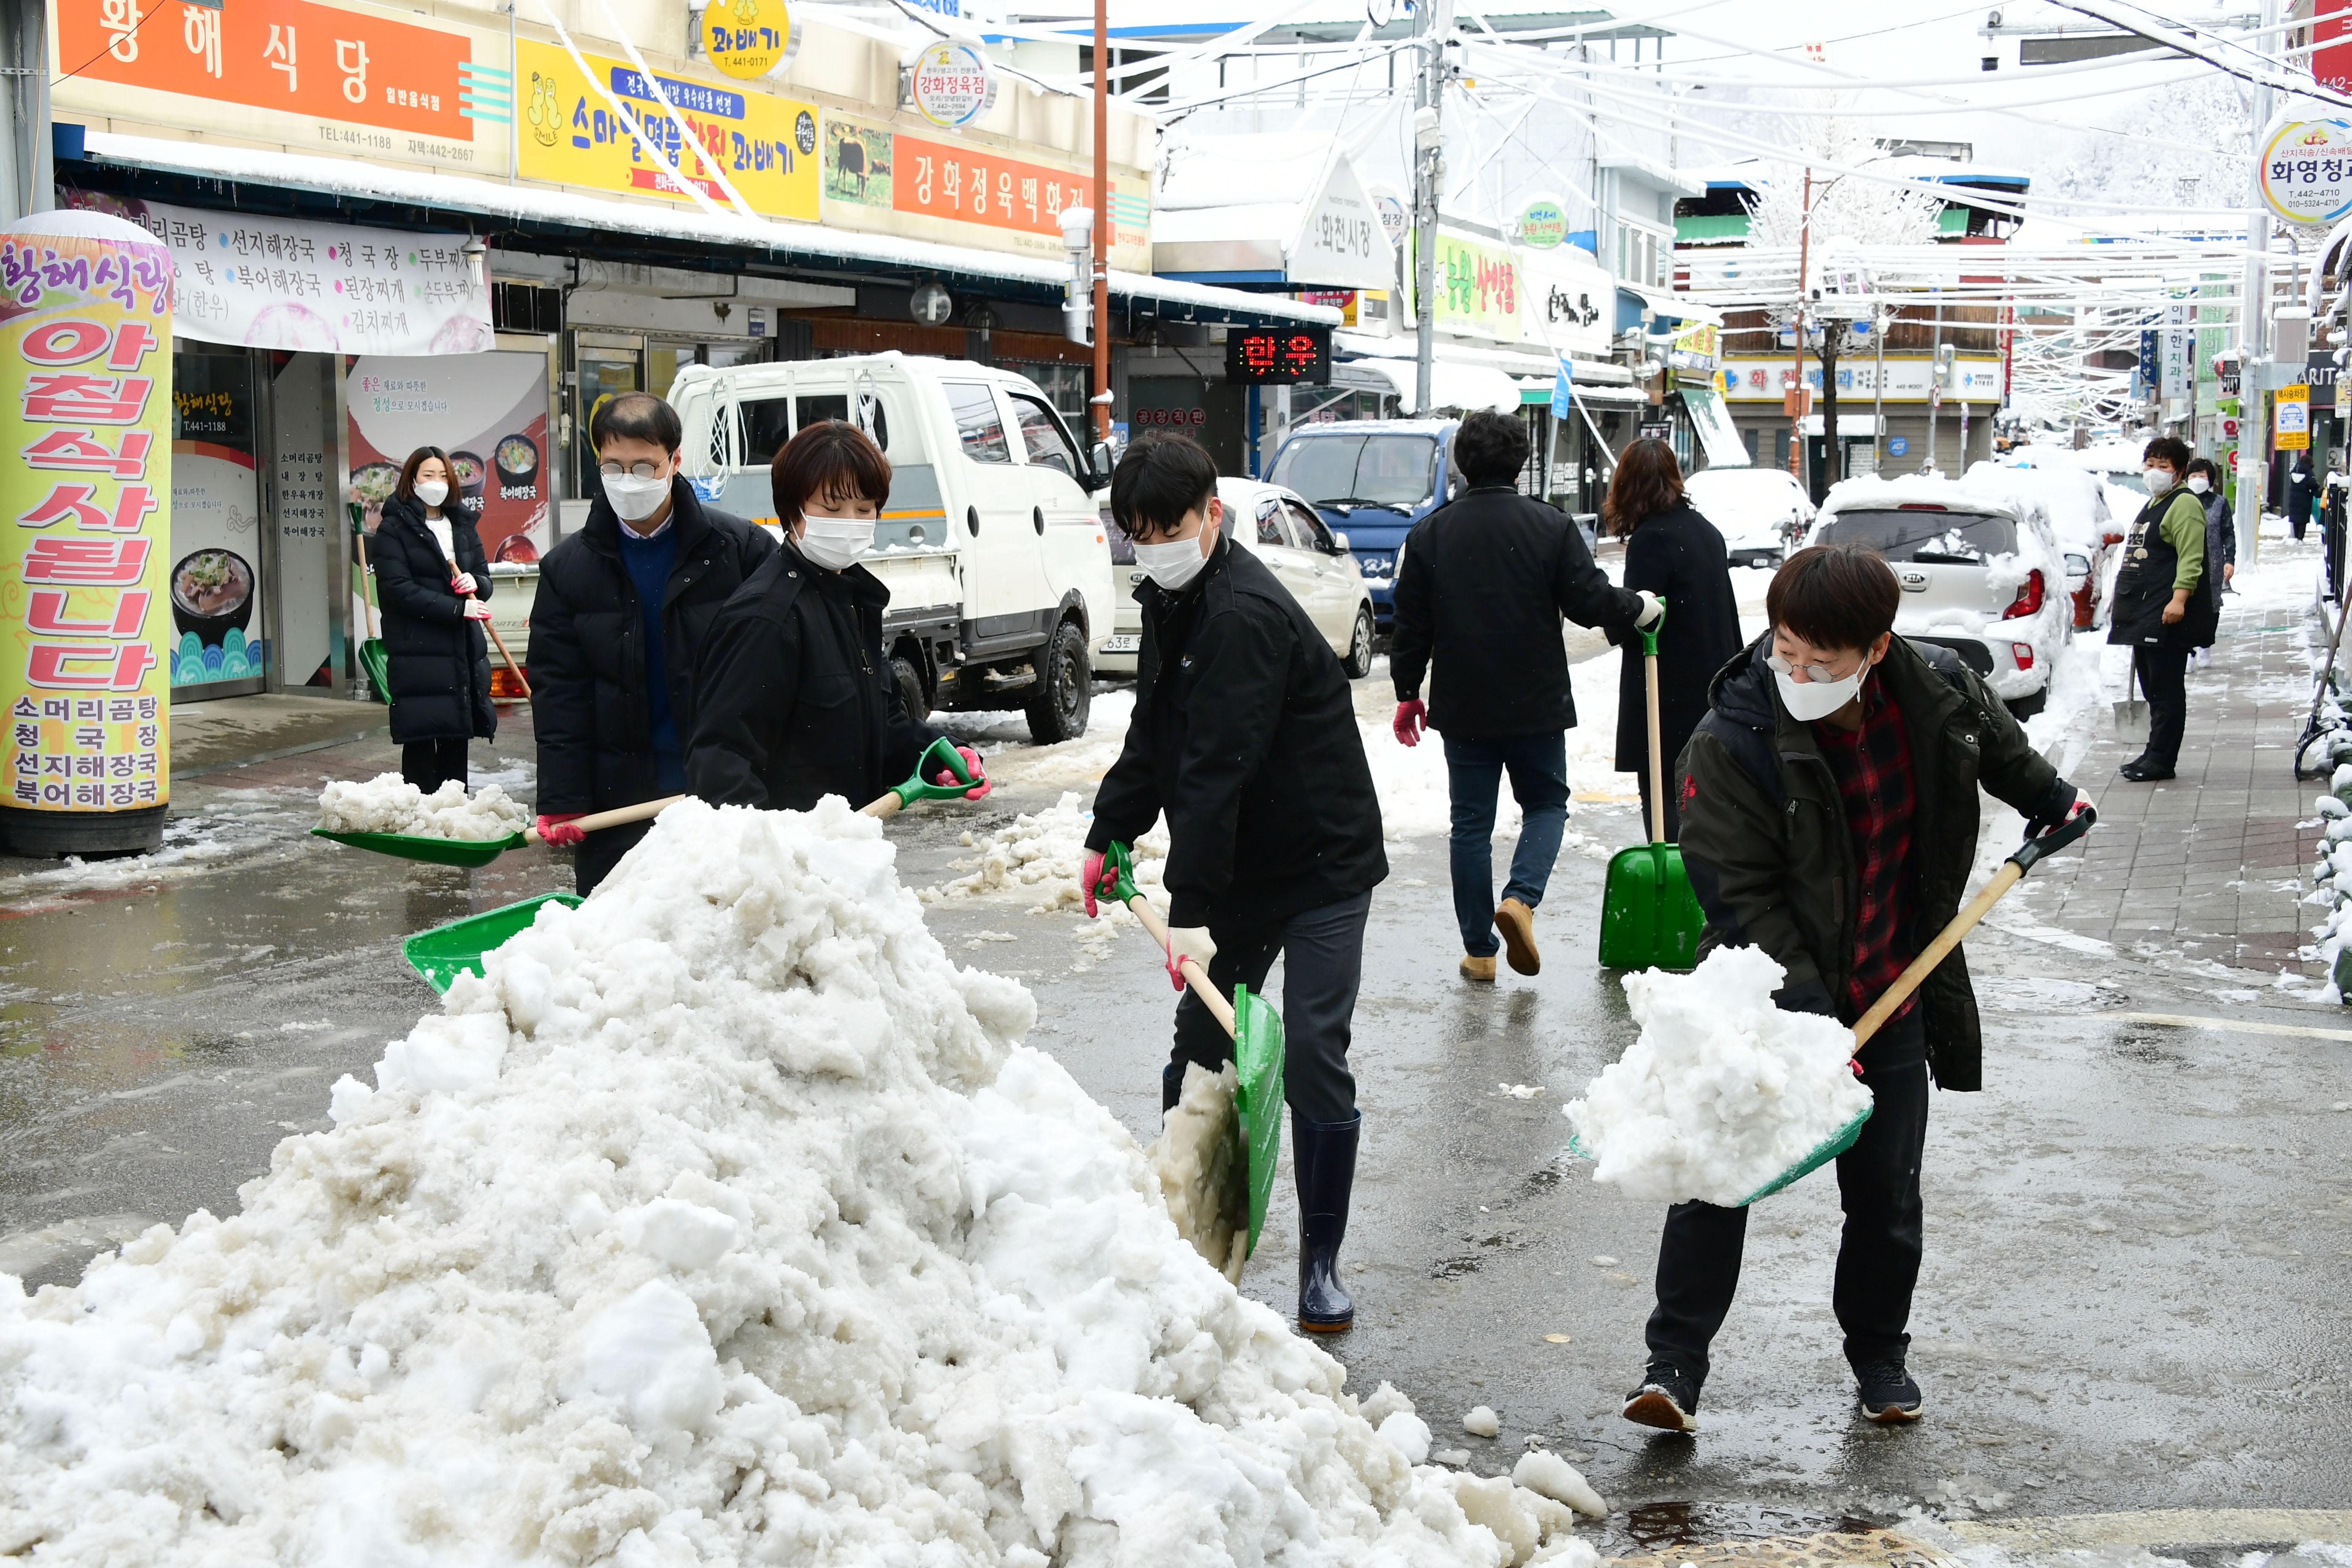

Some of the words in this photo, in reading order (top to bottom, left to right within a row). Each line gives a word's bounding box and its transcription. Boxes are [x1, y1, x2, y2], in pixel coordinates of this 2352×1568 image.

[100, 0, 369, 103] 황해식당
[627, 74, 644, 96] 전국
[683, 87, 713, 110] 우수상품
[716, 93, 732, 115] 선정
[920, 76, 984, 94] 강화정육점
[386, 87, 440, 112] 일반음식점
[319, 126, 391, 150] TEL:441-1188
[408, 139, 474, 162] 자택:442-2667
[534, 127, 558, 142] SMILE
[2288, 199, 2339, 208] 010-5324-4710
[1322, 213, 1371, 259] 화천시장
[232, 229, 315, 264] 선지해장국
[338, 242, 399, 271] 청국장
[1, 244, 167, 313] 황해식당
[237, 265, 321, 298] 북어해장국
[344, 275, 405, 304] 된장찌개
[424, 279, 474, 305] 순두부찌
[351, 309, 410, 336] 김치찌개
[362, 376, 380, 392] 좋은
[383, 380, 403, 392] 재료와
[406, 380, 426, 392] 따뜻한
[2278, 388, 2306, 399] 택시승차장
[174, 391, 232, 416] 황해식당
[373, 396, 405, 412] 정성으로
[407, 400, 449, 412] 모시겠습니다.
[183, 421, 226, 432] T.441-1188
[1138, 410, 1204, 424] 공장직판
[280, 452, 323, 464] 소머리곰탕
[281, 471, 323, 482] 내장탕
[282, 489, 324, 501] 한우육개장
[500, 485, 537, 501] 북어해장국
[283, 508, 325, 519] 선지해장국
[283, 526, 325, 538] 북어해장국
[15, 697, 157, 721] 소머리곰탕
[15, 725, 157, 749] 청국장
[15, 752, 157, 778] 선지해장국
[15, 780, 157, 805] 북어해장국
